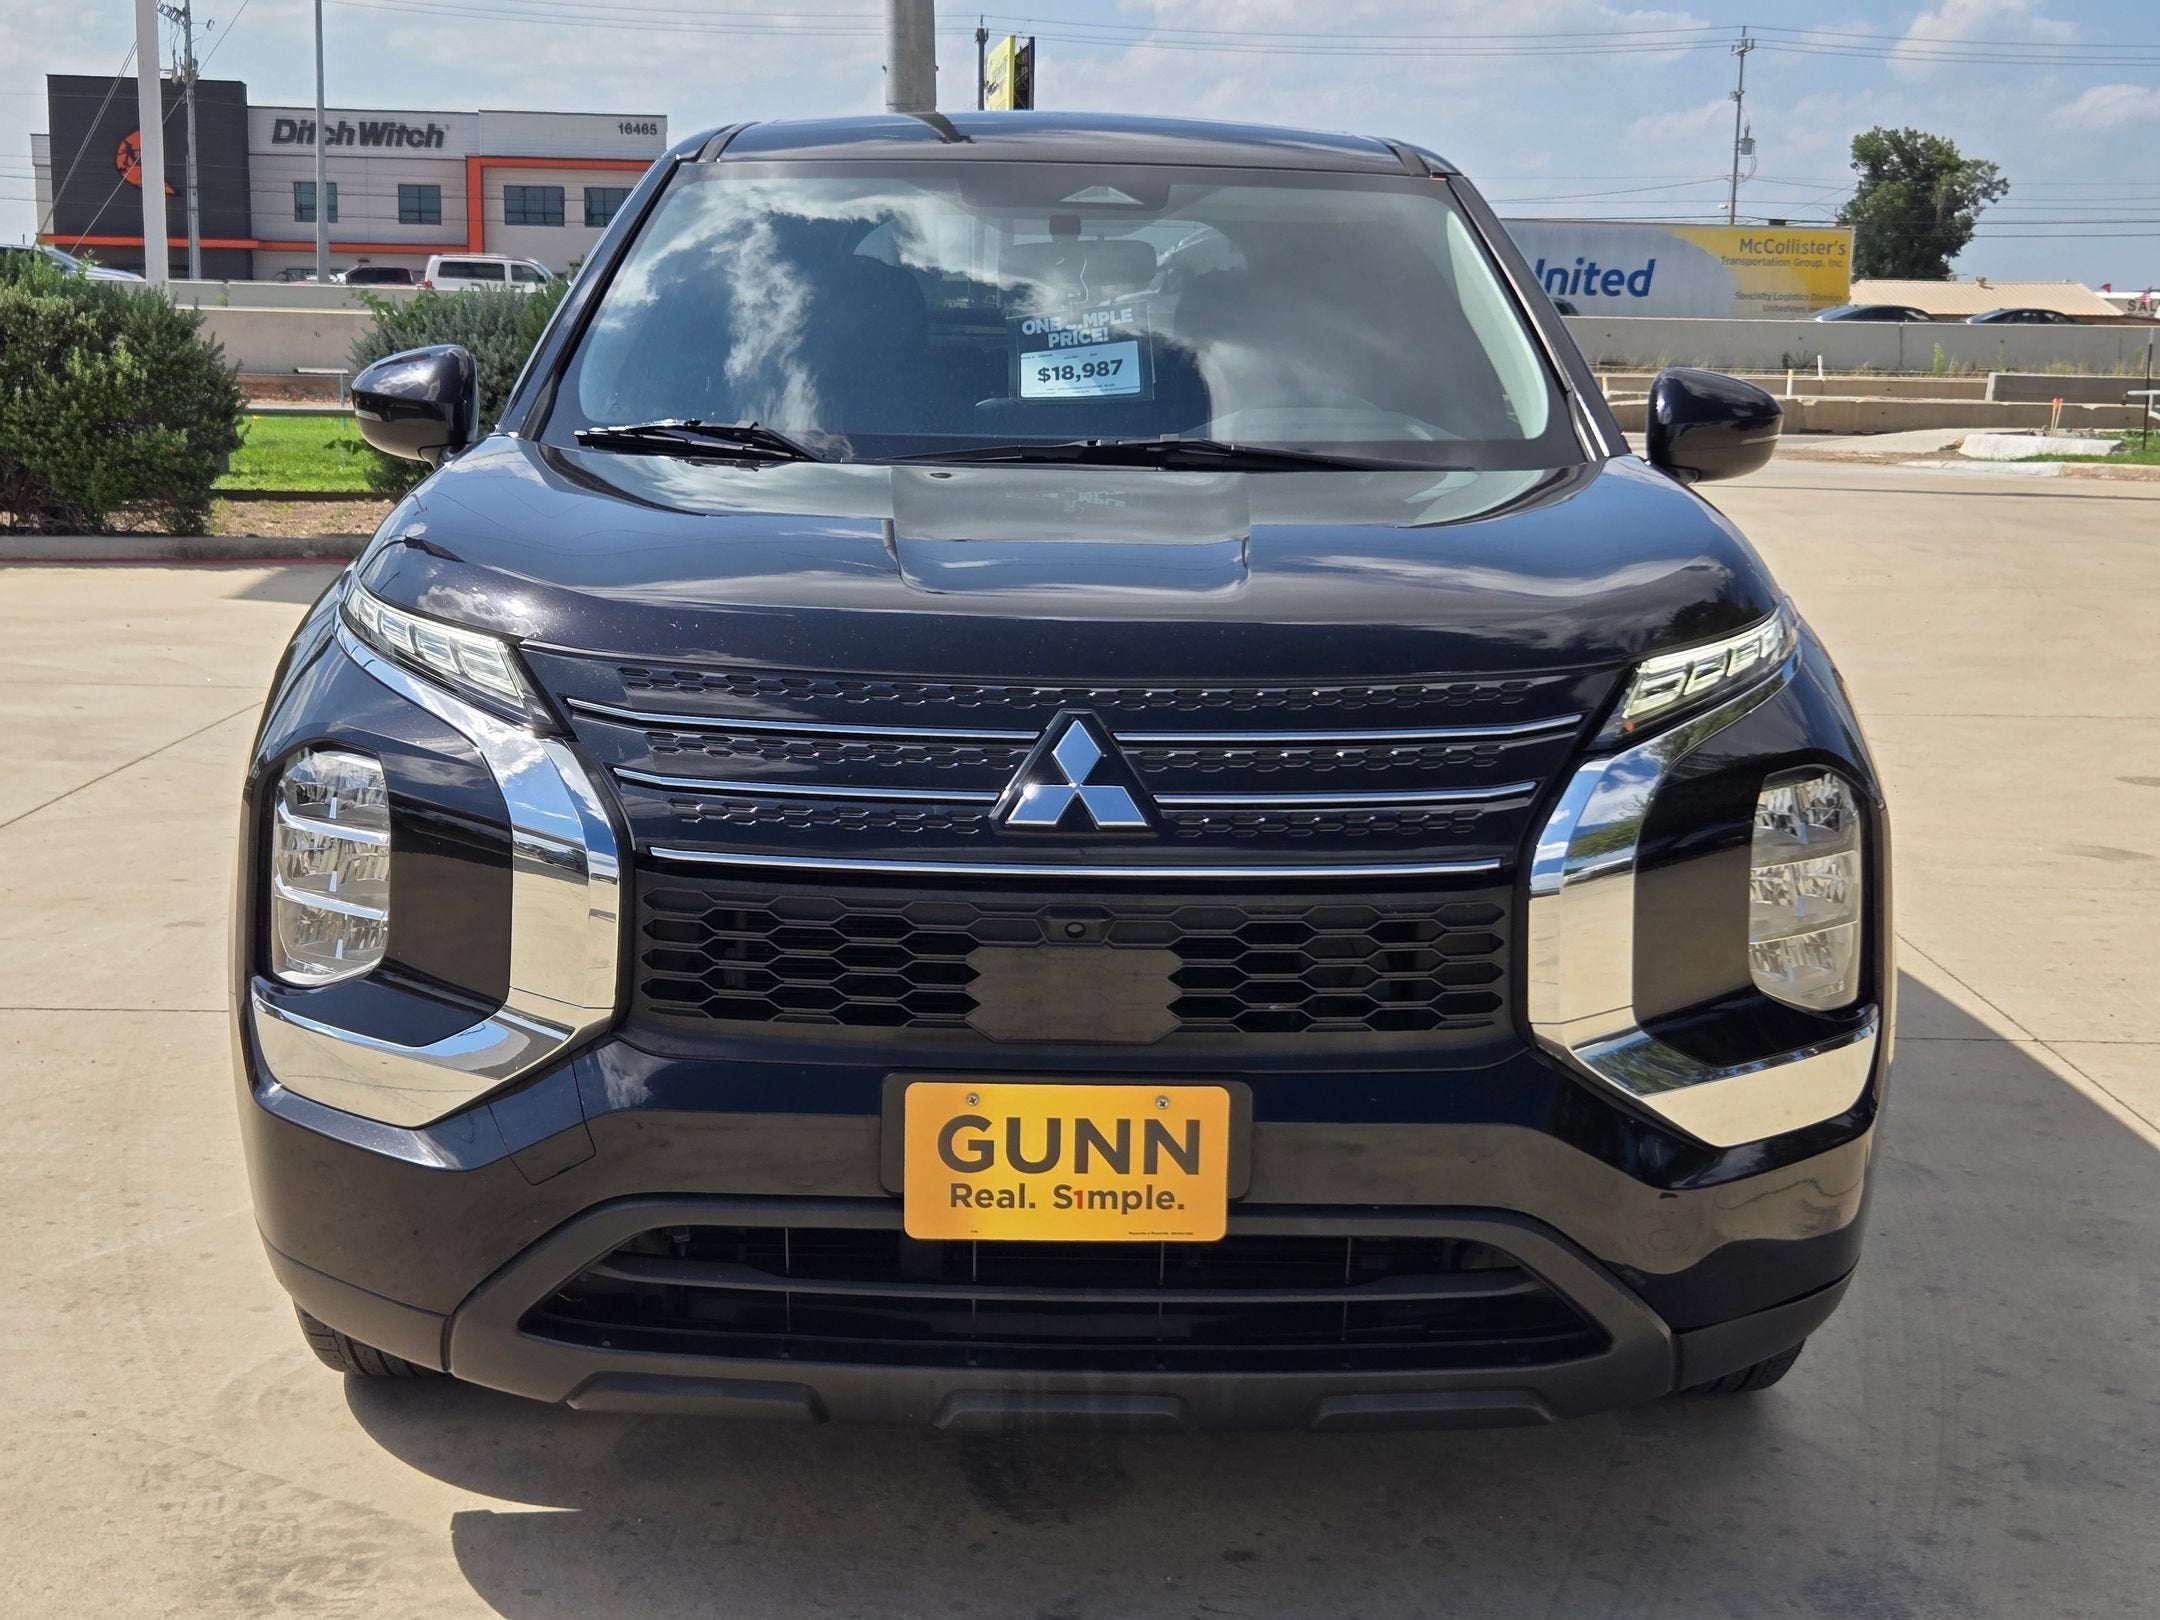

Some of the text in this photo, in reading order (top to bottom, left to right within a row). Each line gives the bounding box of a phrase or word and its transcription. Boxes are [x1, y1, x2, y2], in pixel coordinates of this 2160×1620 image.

[272, 119, 444, 148] Ditch Witch
[618, 122, 658, 136] 16465
[1739, 237, 1847, 256] McCollister's
[1721, 256, 1791, 268] Transportation
[2127, 299, 2160, 313] SAL
[1021, 308, 1134, 336] ONE MPLE
[1047, 326, 1110, 348] PRICE!
[1037, 359, 1124, 384] $18,987
[937, 1114, 1201, 1175] GUNN
[950, 1182, 1036, 1209] Real.
